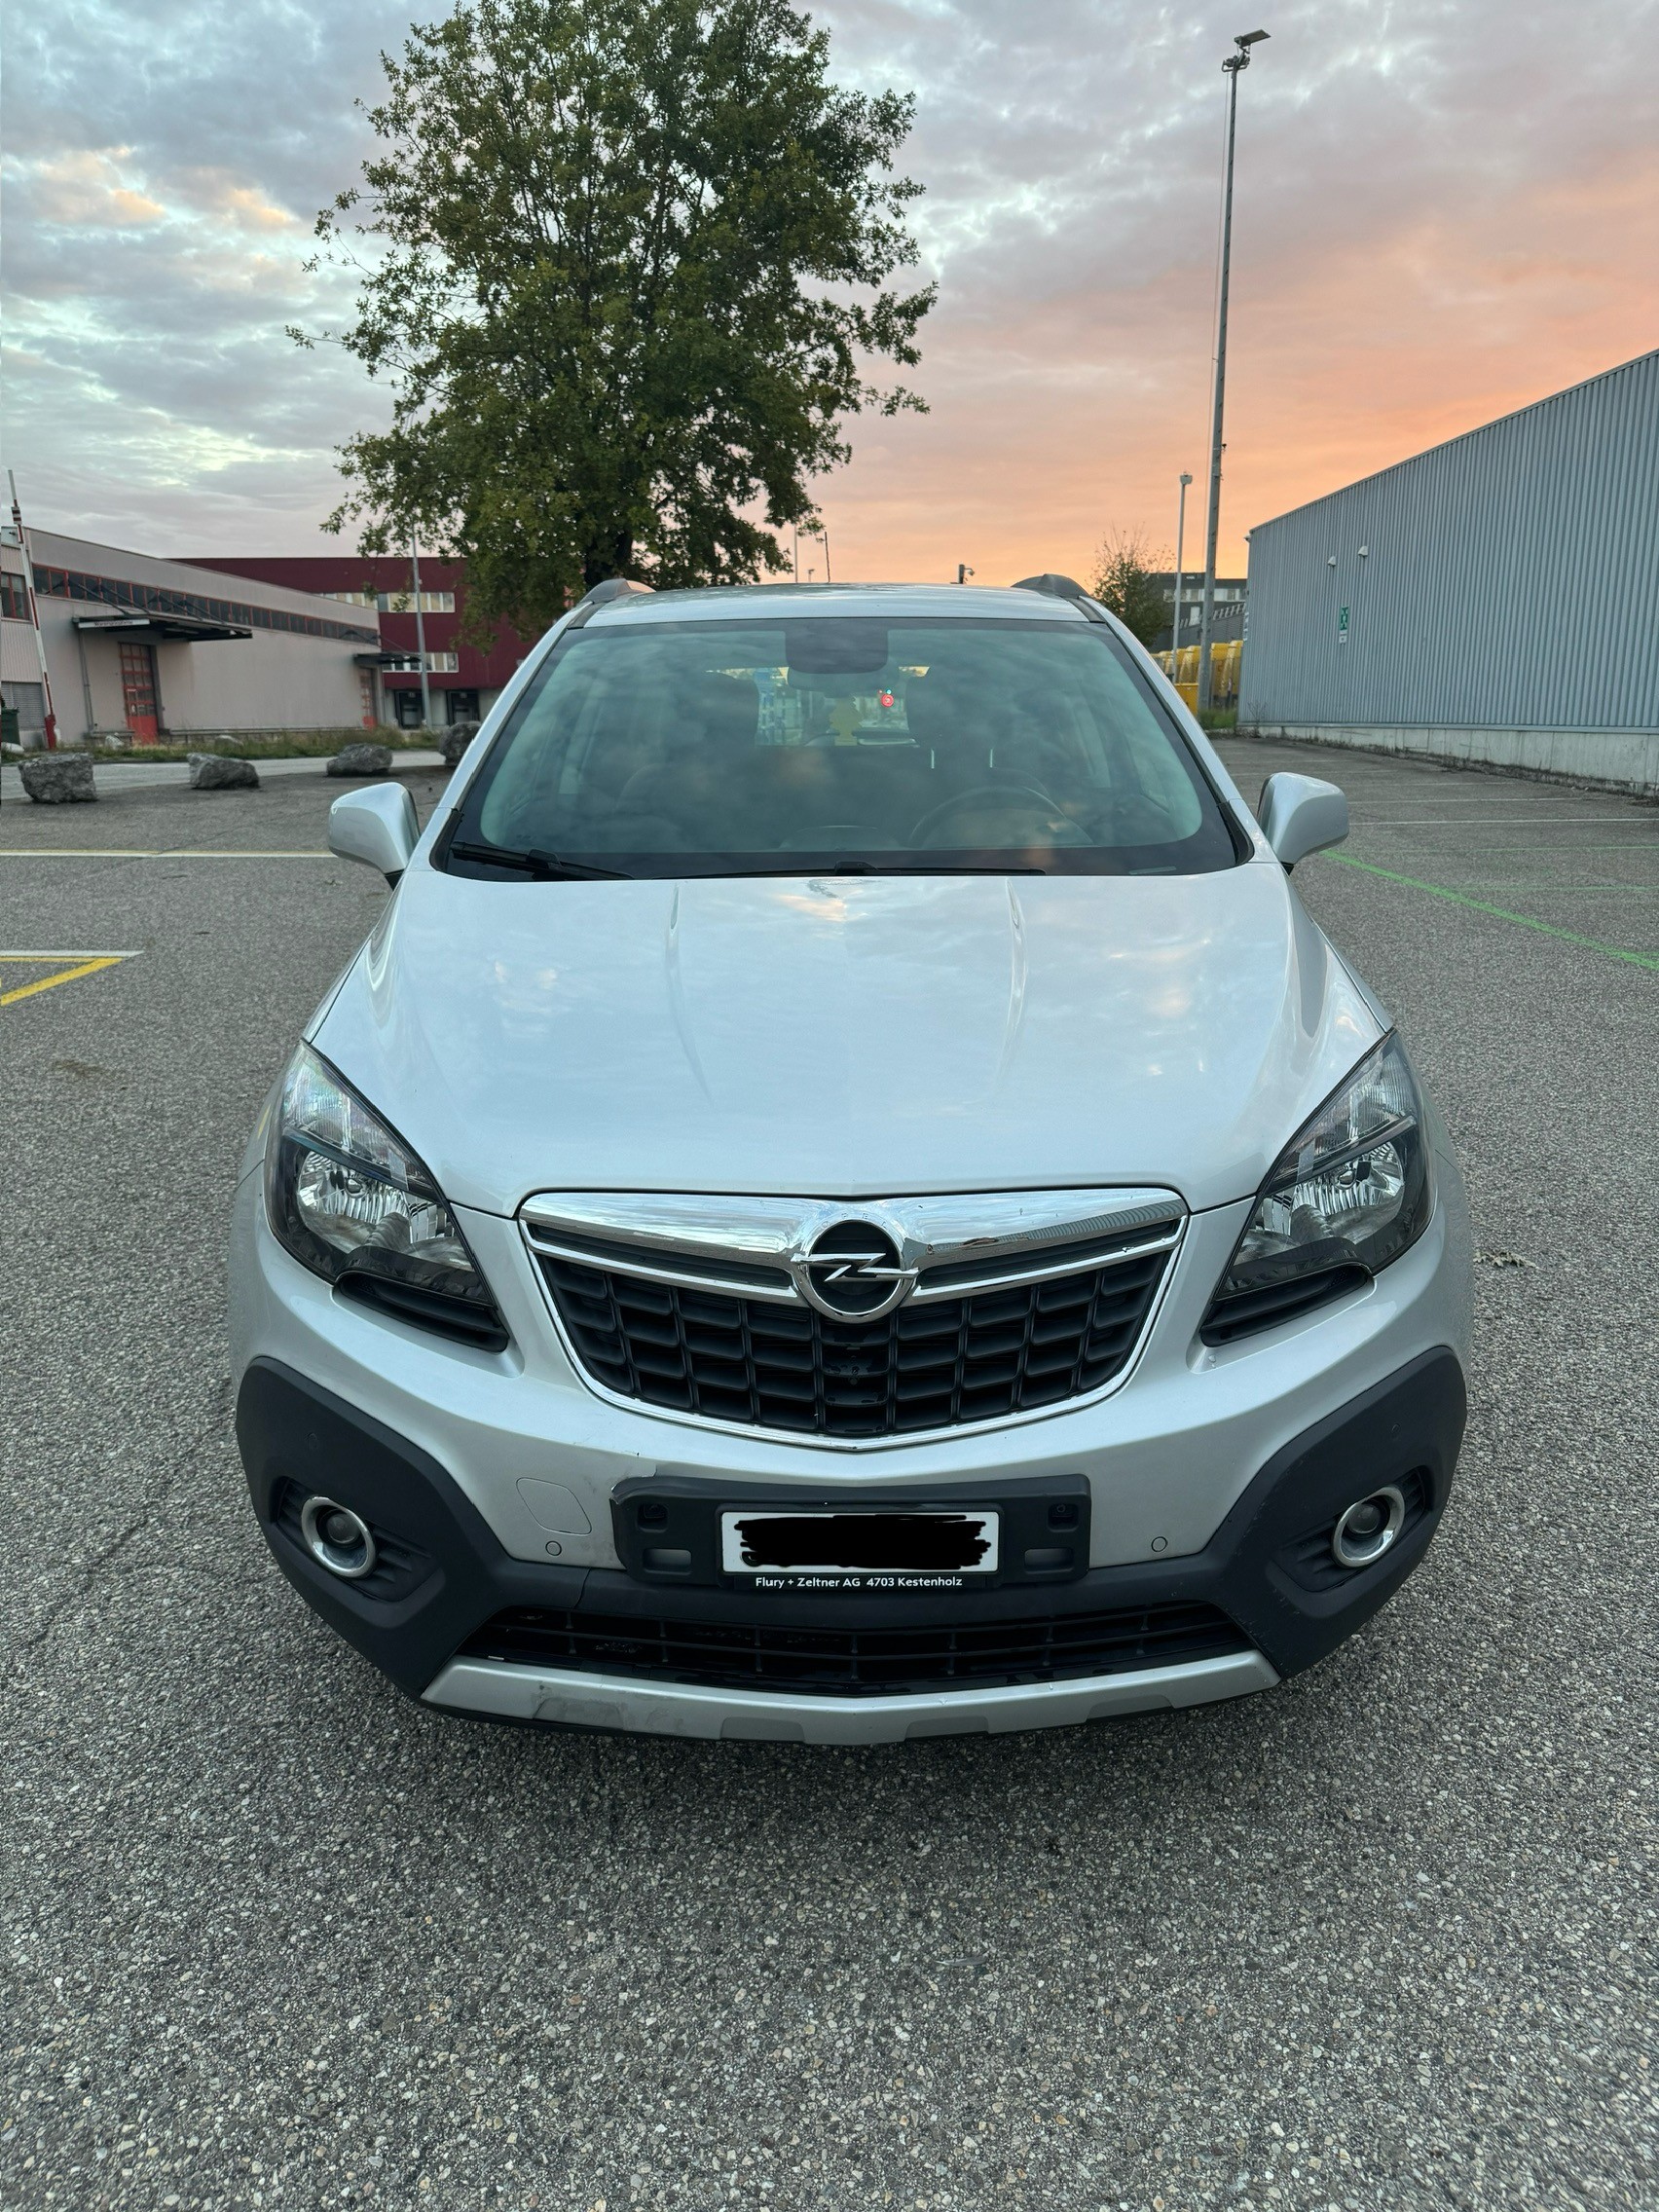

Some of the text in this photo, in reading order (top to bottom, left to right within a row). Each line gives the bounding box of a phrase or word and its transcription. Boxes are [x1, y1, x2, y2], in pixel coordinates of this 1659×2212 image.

[821, 1212, 887, 1230] OPEL
[756, 1576, 785, 1589] Flury
[796, 1576, 840, 1587] Zeltner
[842, 1576, 861, 1587] AG
[866, 1576, 895, 1587] 4703
[898, 1575, 963, 1587] Kestenholz
